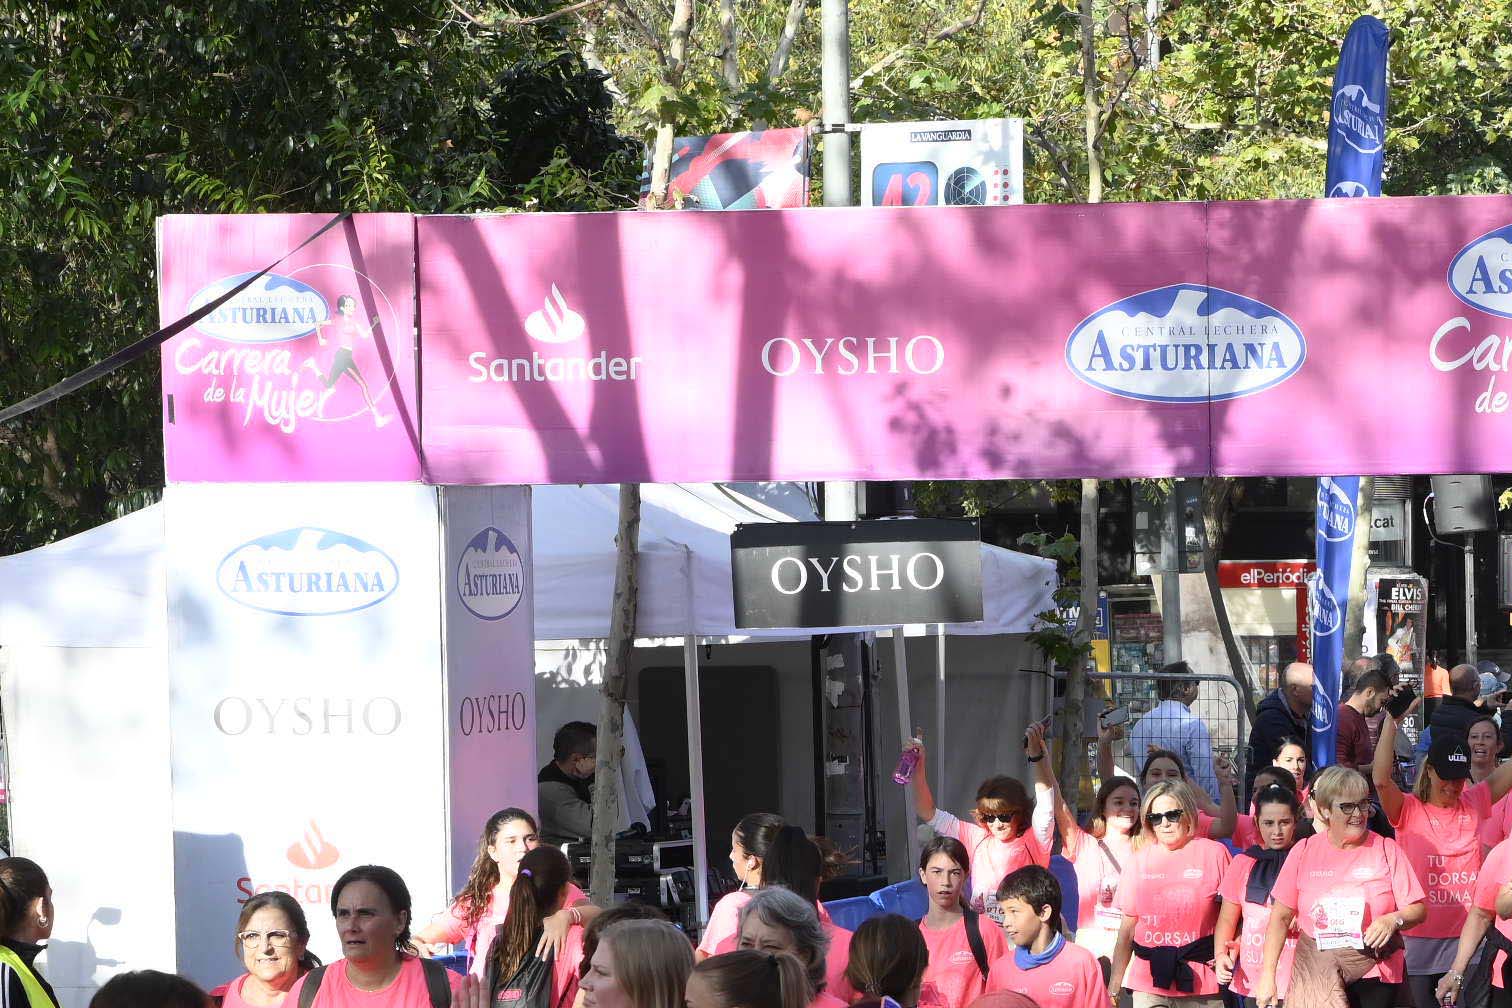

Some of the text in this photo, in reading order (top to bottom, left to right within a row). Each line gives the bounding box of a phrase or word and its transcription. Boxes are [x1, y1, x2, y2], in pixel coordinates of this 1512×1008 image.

[1121, 323, 1280, 338] CENTRAL LECHERA
[174, 337, 292, 376] Carrera
[468, 350, 643, 382] Santander
[761, 335, 945, 378] OYSHO
[1084, 335, 1288, 373] ASTURIANA
[204, 375, 245, 404] de la
[243, 372, 337, 434] Mujer
[1475, 374, 1511, 414] de
[230, 560, 385, 593] ASTURIANA
[462, 565, 520, 598] ASTURIANA
[770, 552, 945, 595] OYSHO
[1391, 587, 1423, 601] ELVIS
[213, 696, 401, 737] OYSHO
[460, 691, 526, 737] OYSHO
[1428, 855, 1446, 869] TU
[1428, 889, 1472, 904] SUMA
